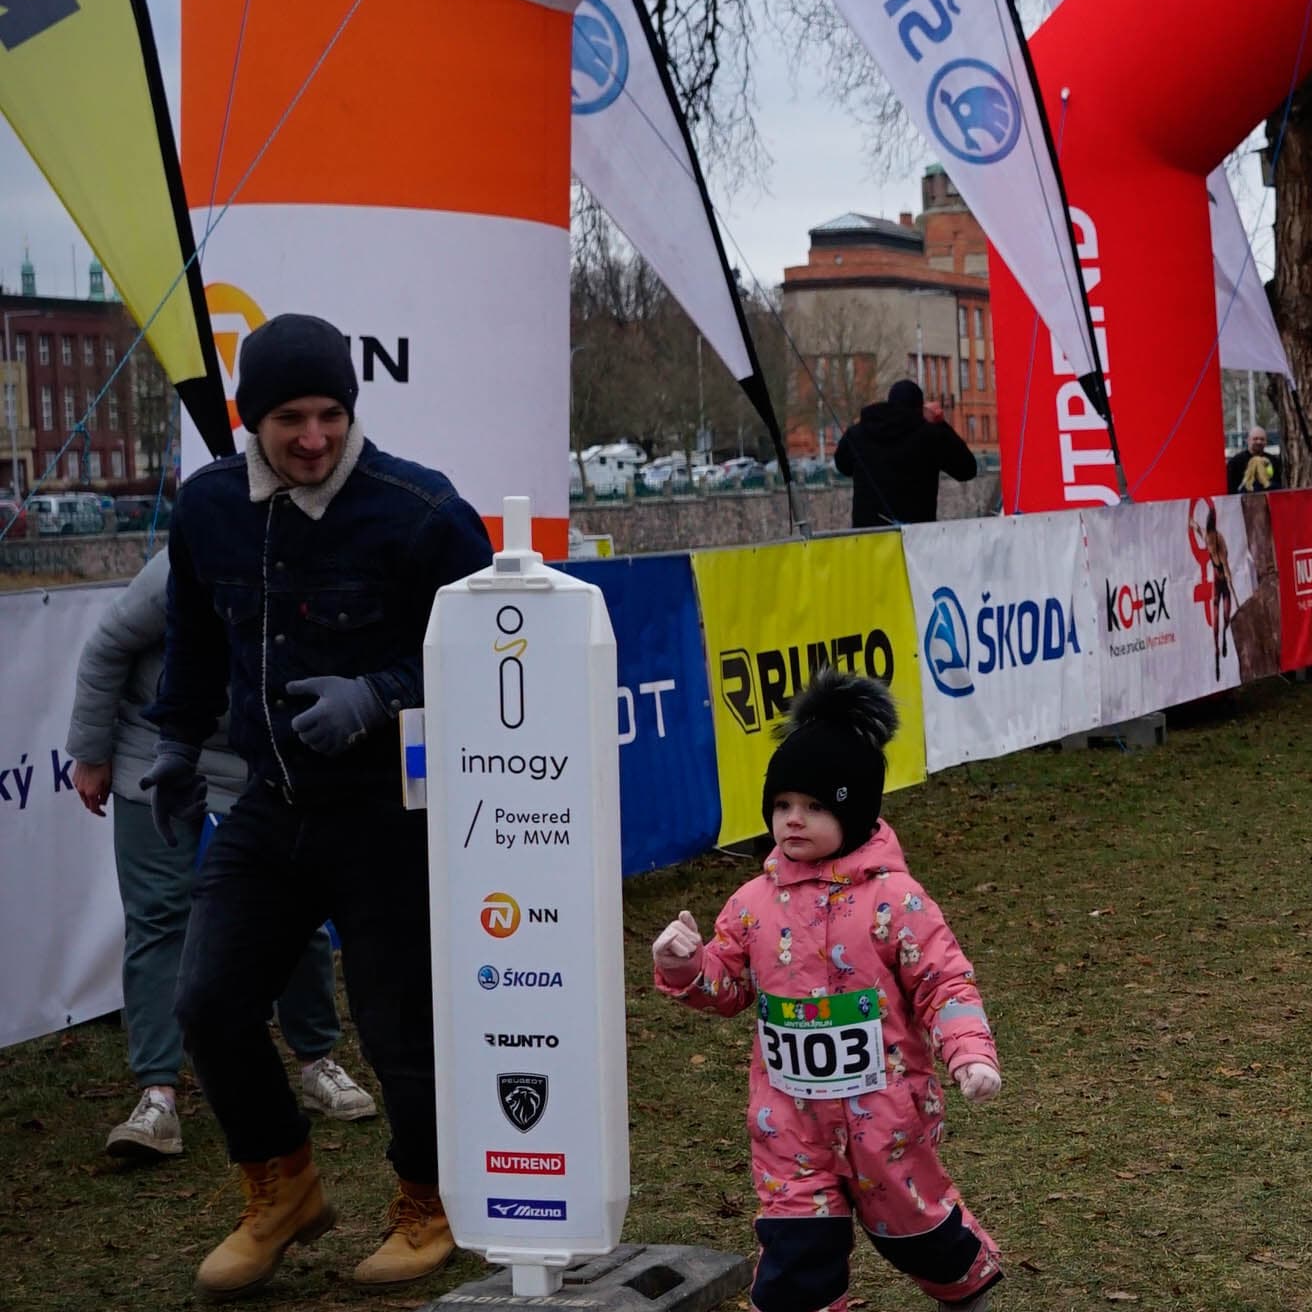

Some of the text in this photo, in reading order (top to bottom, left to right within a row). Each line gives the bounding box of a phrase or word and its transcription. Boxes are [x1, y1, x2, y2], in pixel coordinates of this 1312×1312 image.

[977, 592, 1082, 674] ŠKODA
[461, 747, 569, 780] innogy
[495, 808, 570, 824] Powered
[495, 829, 570, 849] by MVM
[528, 908, 559, 923] NN
[503, 968, 563, 988] ŠKODA
[498, 1034, 559, 1048] RUNTO
[763, 1026, 871, 1077] 3103
[490, 1156, 561, 1171] NUTREND
